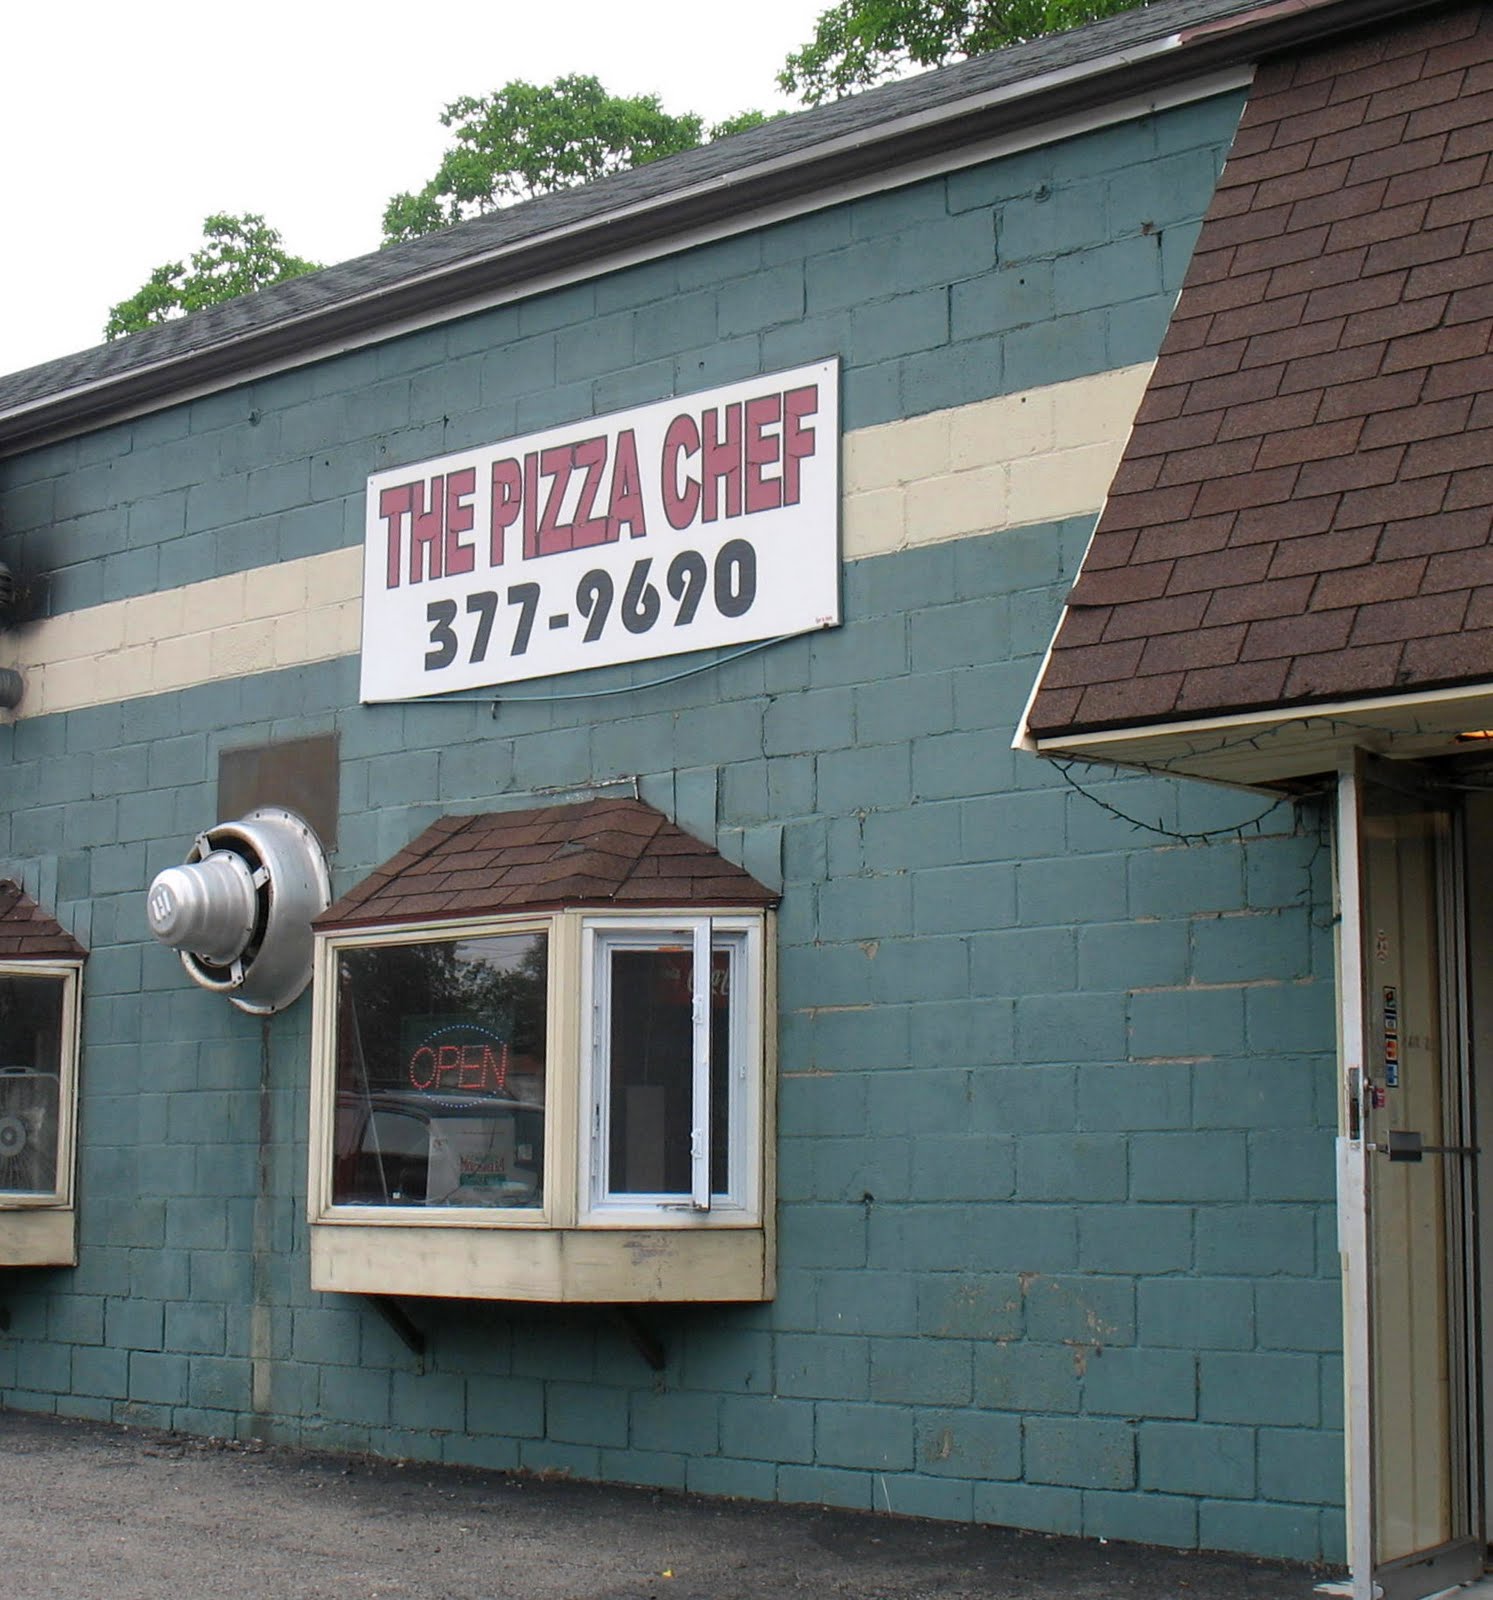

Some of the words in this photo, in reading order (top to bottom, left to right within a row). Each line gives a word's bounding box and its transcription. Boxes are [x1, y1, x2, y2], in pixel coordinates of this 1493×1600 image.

[379, 467, 476, 589] THE
[489, 428, 647, 567] PIZZA
[661, 384, 818, 530] CHEF
[424, 538, 757, 672] 377-9690
[410, 1044, 508, 1090] OPEN
